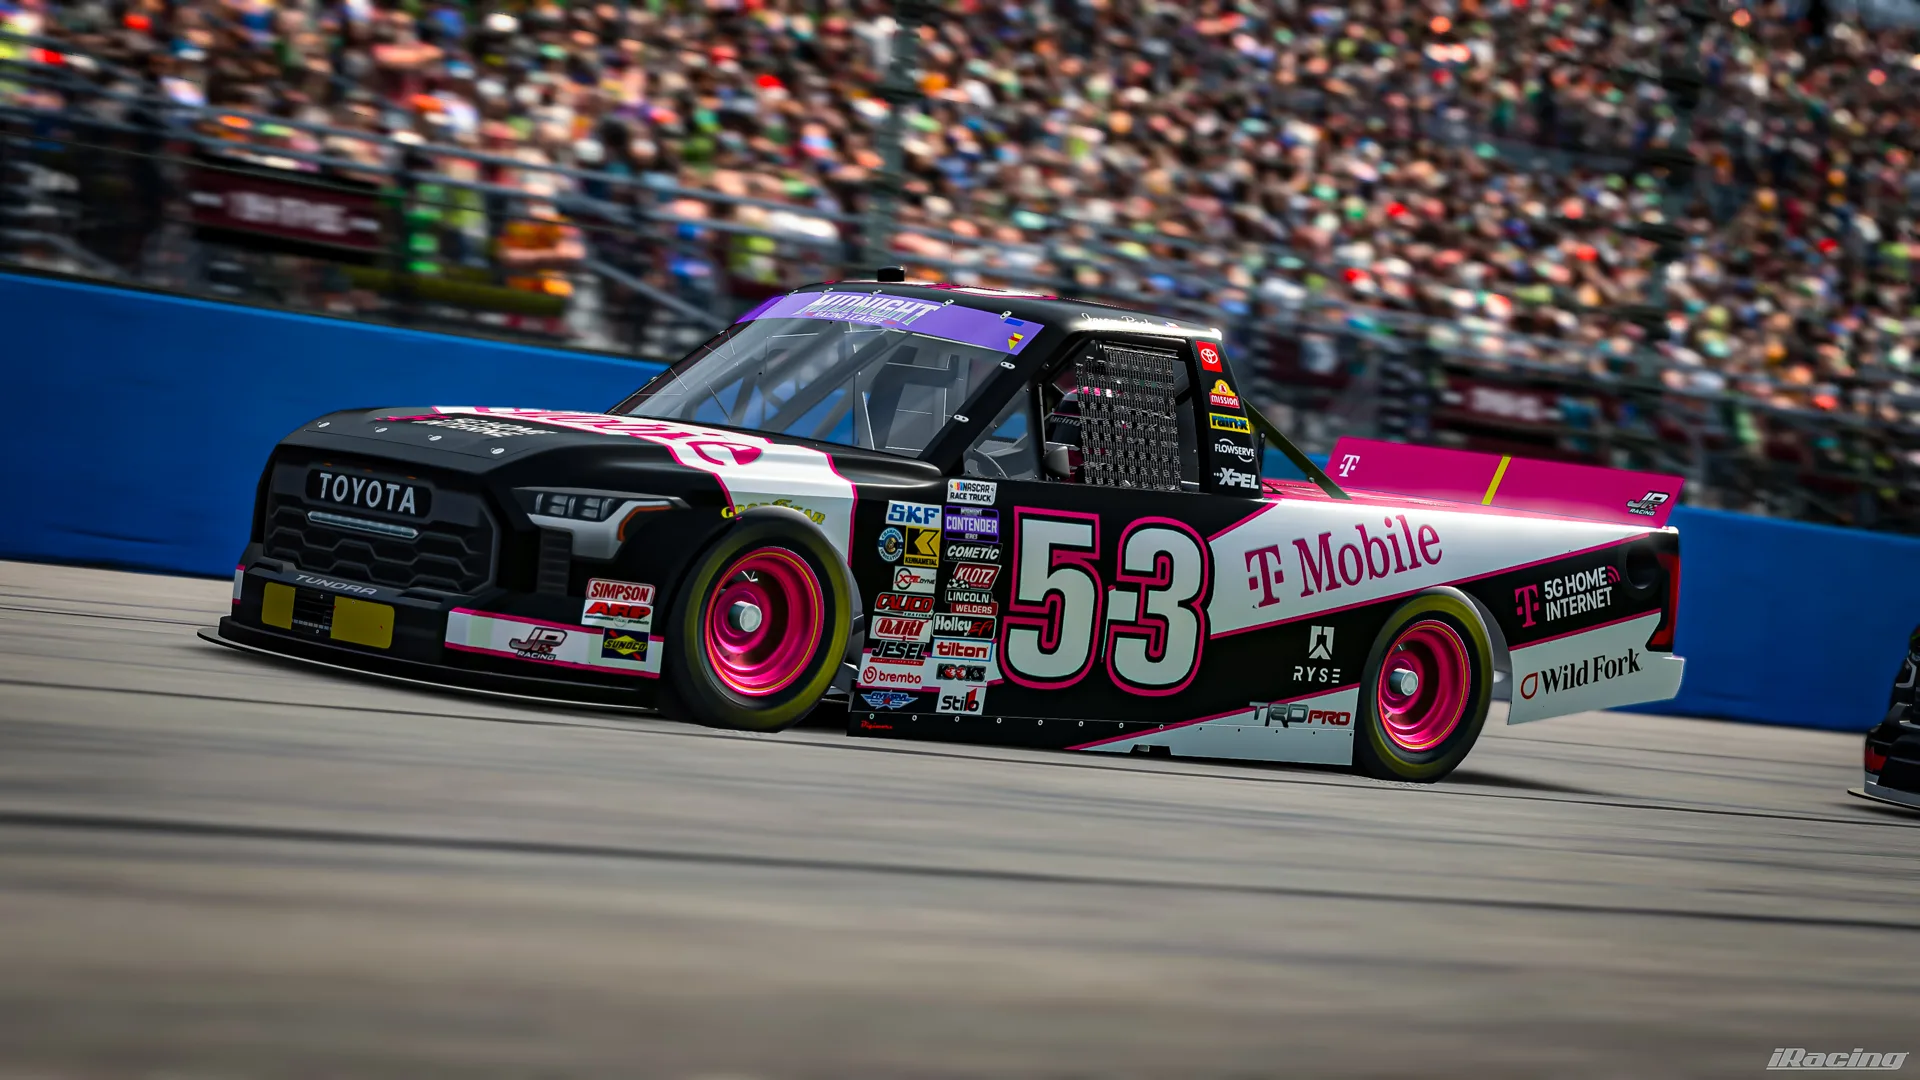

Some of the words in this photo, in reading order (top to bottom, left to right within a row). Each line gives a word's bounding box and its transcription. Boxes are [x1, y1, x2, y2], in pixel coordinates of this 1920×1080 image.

[792, 294, 941, 326] MIDNIGHT
[811, 311, 848, 320] RACING
[844, 314, 887, 324] LEAGUE
[1214, 443, 1254, 458] FLOWSERVE
[1338, 454, 1360, 477] T
[962, 482, 990, 493] NASCAR
[1218, 467, 1259, 489] XPEL
[319, 472, 416, 515] TOYOTA
[950, 492, 967, 500] RACE
[969, 493, 991, 502] TRUCK
[888, 504, 940, 525] SKF
[1629, 508, 1656, 516] RACING
[946, 515, 998, 534] CONTENDER
[946, 545, 1000, 560] COMETIC
[1245, 544, 1285, 608] T
[1292, 514, 1443, 597] Mobile
[296, 574, 377, 596] TUNDRA
[955, 567, 996, 584] KLOTZ
[1544, 578, 1563, 600] 5G
[1565, 566, 1608, 595] HOME
[591, 582, 650, 602] SIMPSON
[947, 591, 990, 604] LINCOLN
[1002, 506, 1214, 696] 53
[584, 601, 652, 620] ARP
[876, 593, 934, 613] CALICO
[955, 604, 993, 615] WELDERS
[1514, 584, 1540, 628] T
[1545, 586, 1612, 622] INTERNET
[934, 615, 972, 636] Holley
[604, 638, 647, 652] SUNOCO
[872, 640, 926, 660] JESEL
[936, 641, 988, 658] tilton
[517, 650, 557, 661] RACING
[879, 668, 922, 684] brembo
[1293, 665, 1341, 684] RYSE
[1541, 659, 1588, 695] Wild
[1592, 648, 1641, 684] Fork
[1249, 701, 1310, 728] TRD
[1307, 709, 1352, 726] PRO
